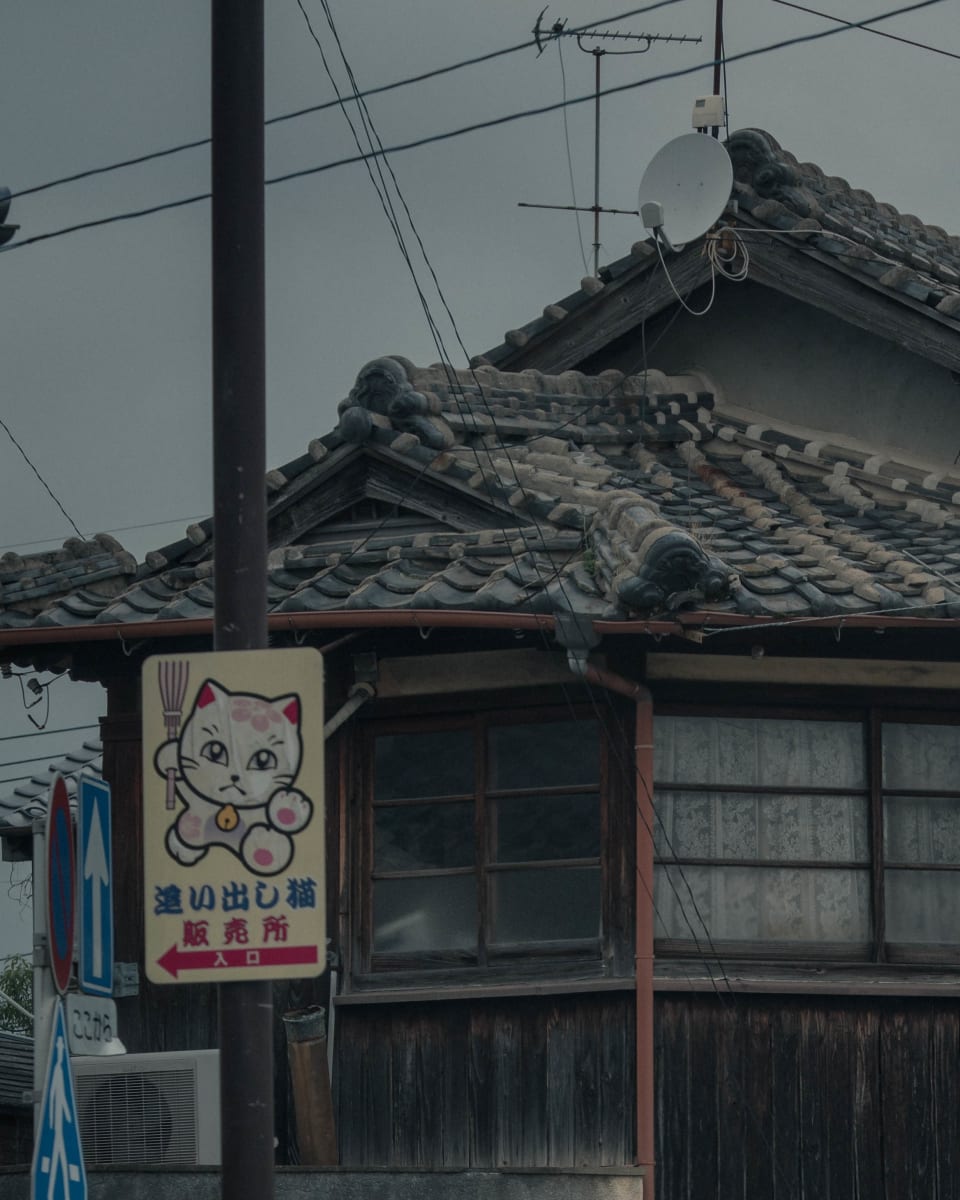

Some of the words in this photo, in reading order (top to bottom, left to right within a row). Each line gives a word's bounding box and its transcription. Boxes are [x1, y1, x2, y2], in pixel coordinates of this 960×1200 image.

[155, 877, 317, 916] 追い出し猫
[183, 915, 290, 947] 販売所
[214, 950, 260, 968] 入口
[73, 1009, 112, 1043] ここから
